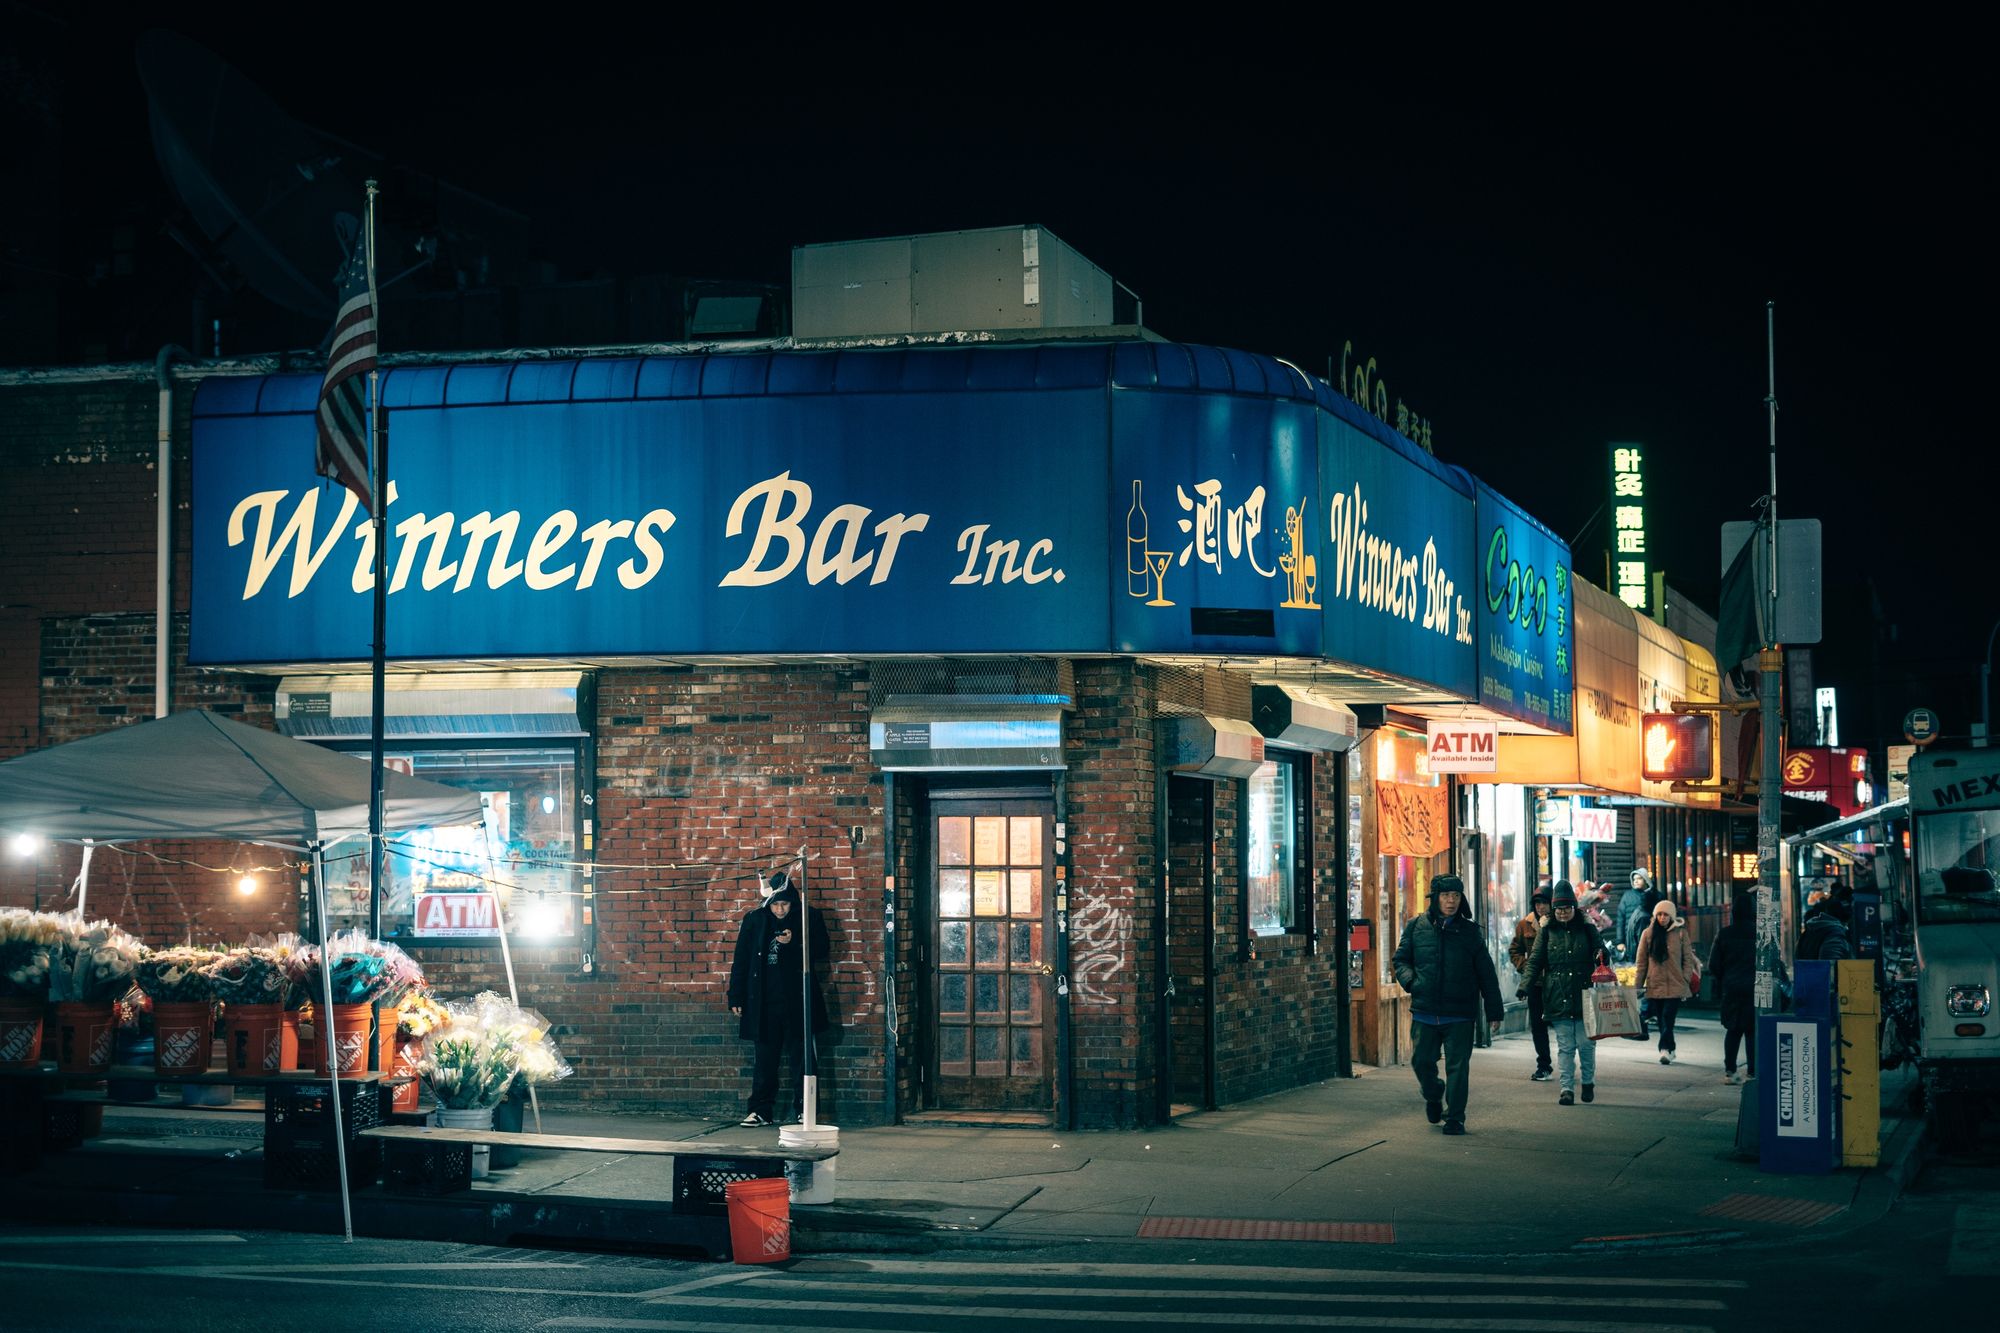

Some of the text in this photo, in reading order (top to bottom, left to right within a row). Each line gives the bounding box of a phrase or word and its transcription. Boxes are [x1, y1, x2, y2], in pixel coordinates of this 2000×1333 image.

[1614, 448, 1643, 496] 針灸
[227, 470, 1066, 600] Winners Bar Inc.
[1177, 479, 1277, 577] 酒吧
[1615, 505, 1646, 553] 痛症
[1331, 481, 1473, 646] Winners Bar Inc.
[1555, 561, 1569, 676] 椰子林
[1490, 633, 1544, 681] Malaysian Cuisine
[1431, 732, 1493, 753] ATM
[1469, 755, 1495, 763] Inside
[1786, 756, 1811, 780] 金
[524, 849, 568, 858] COCKTAIL
[424, 895, 493, 928] ATM
[161, 1028, 198, 1067] HOME
[163, 1031, 179, 1049] THE
[176, 1041, 200, 1066] DEPOT
[341, 1047, 362, 1071] DEPOT
[1803, 1064, 1810, 1077] TO
